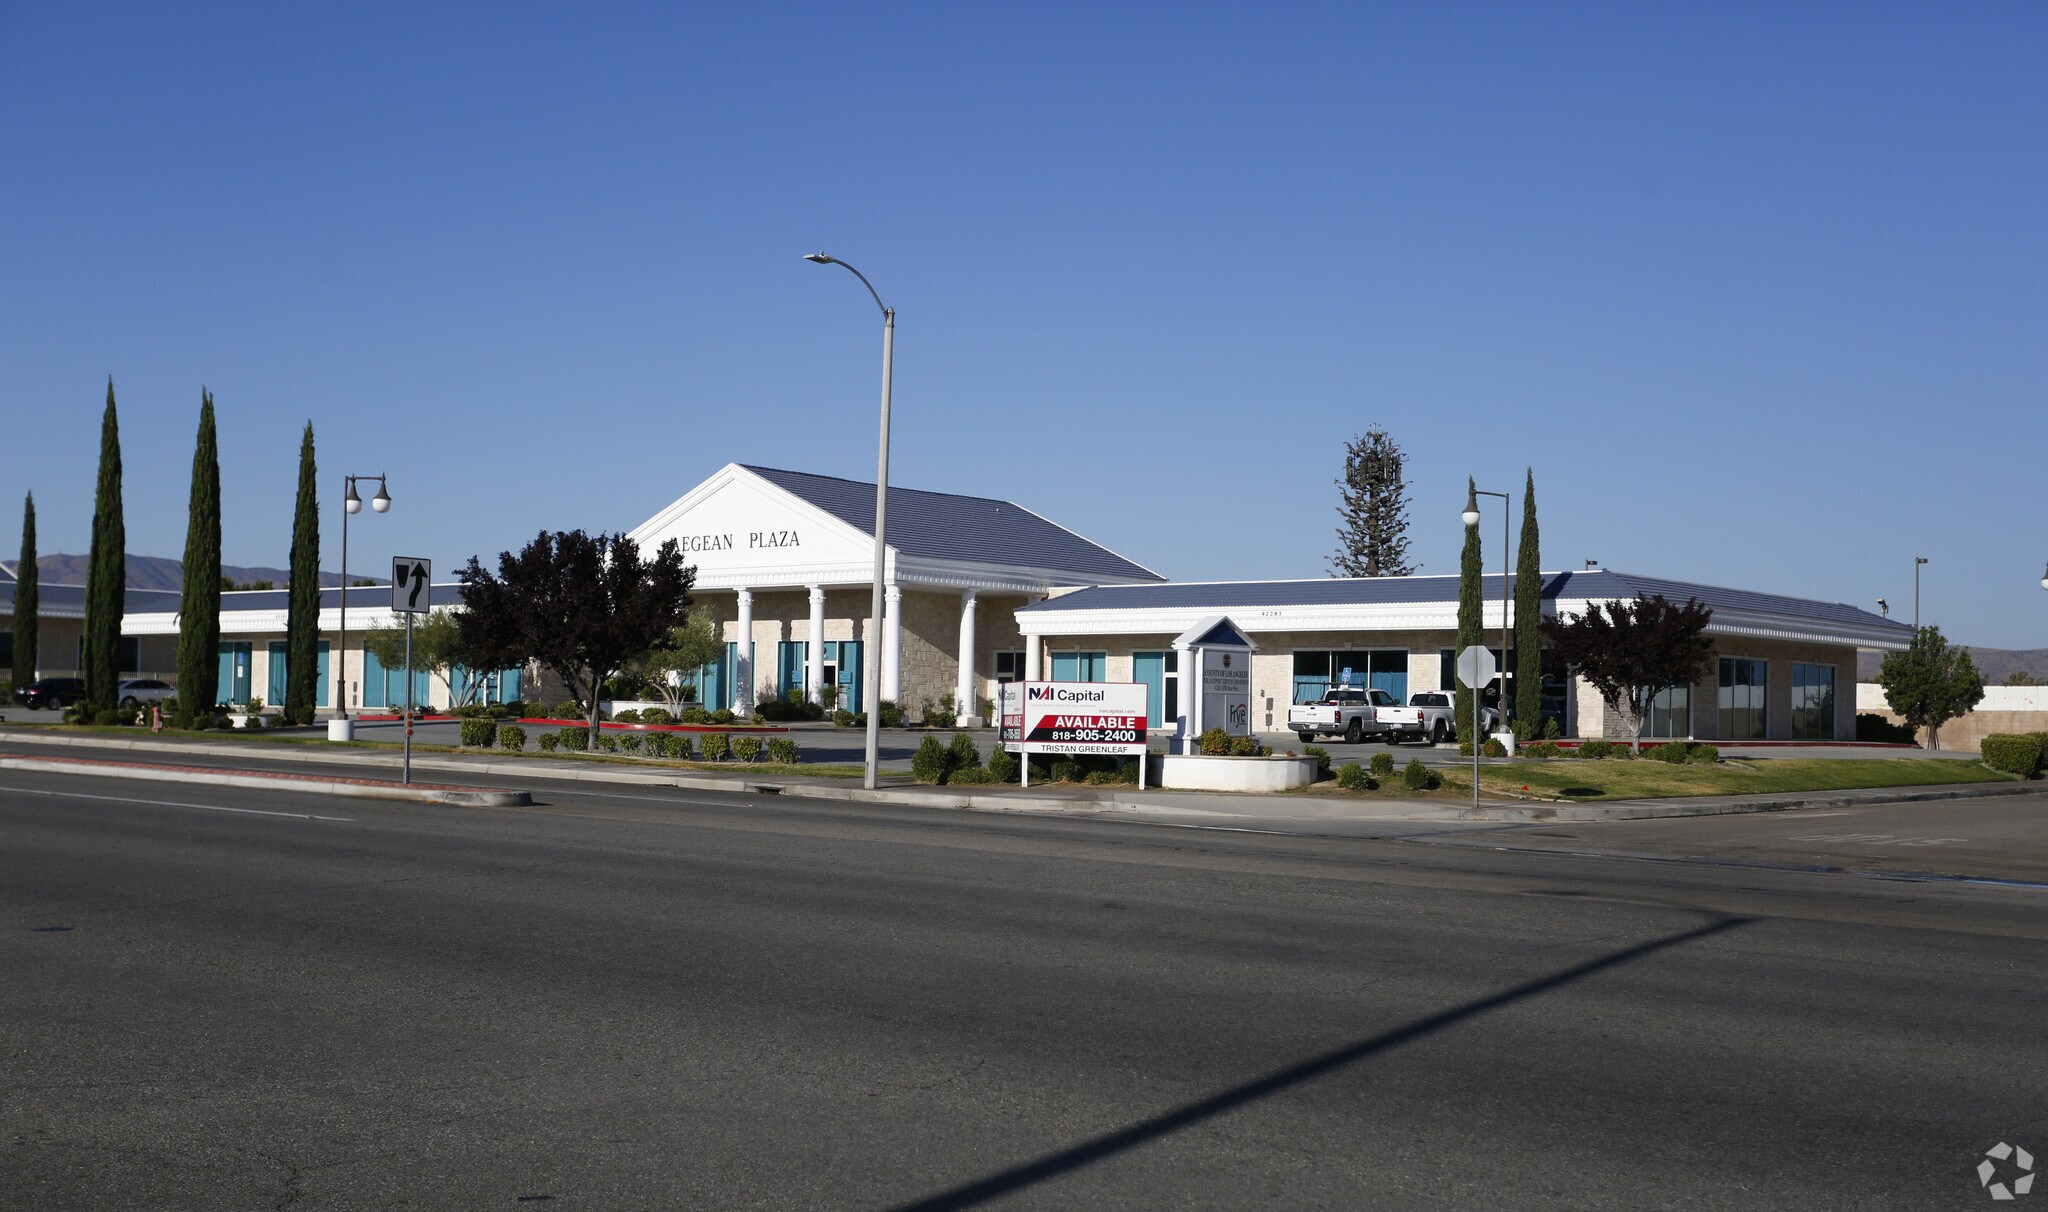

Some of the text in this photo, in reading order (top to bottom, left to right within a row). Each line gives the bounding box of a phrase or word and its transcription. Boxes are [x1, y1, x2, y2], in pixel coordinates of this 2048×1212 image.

[749, 530, 800, 549] PLAZA
[1029, 685, 1104, 703] NAI Capital
[1054, 716, 1136, 729] AVAILABLE
[1230, 704, 1246, 728] Frye
[1052, 729, 1136, 742] 818-905-2400
[1041, 744, 1128, 753] TRISTAN GREENLEAF
